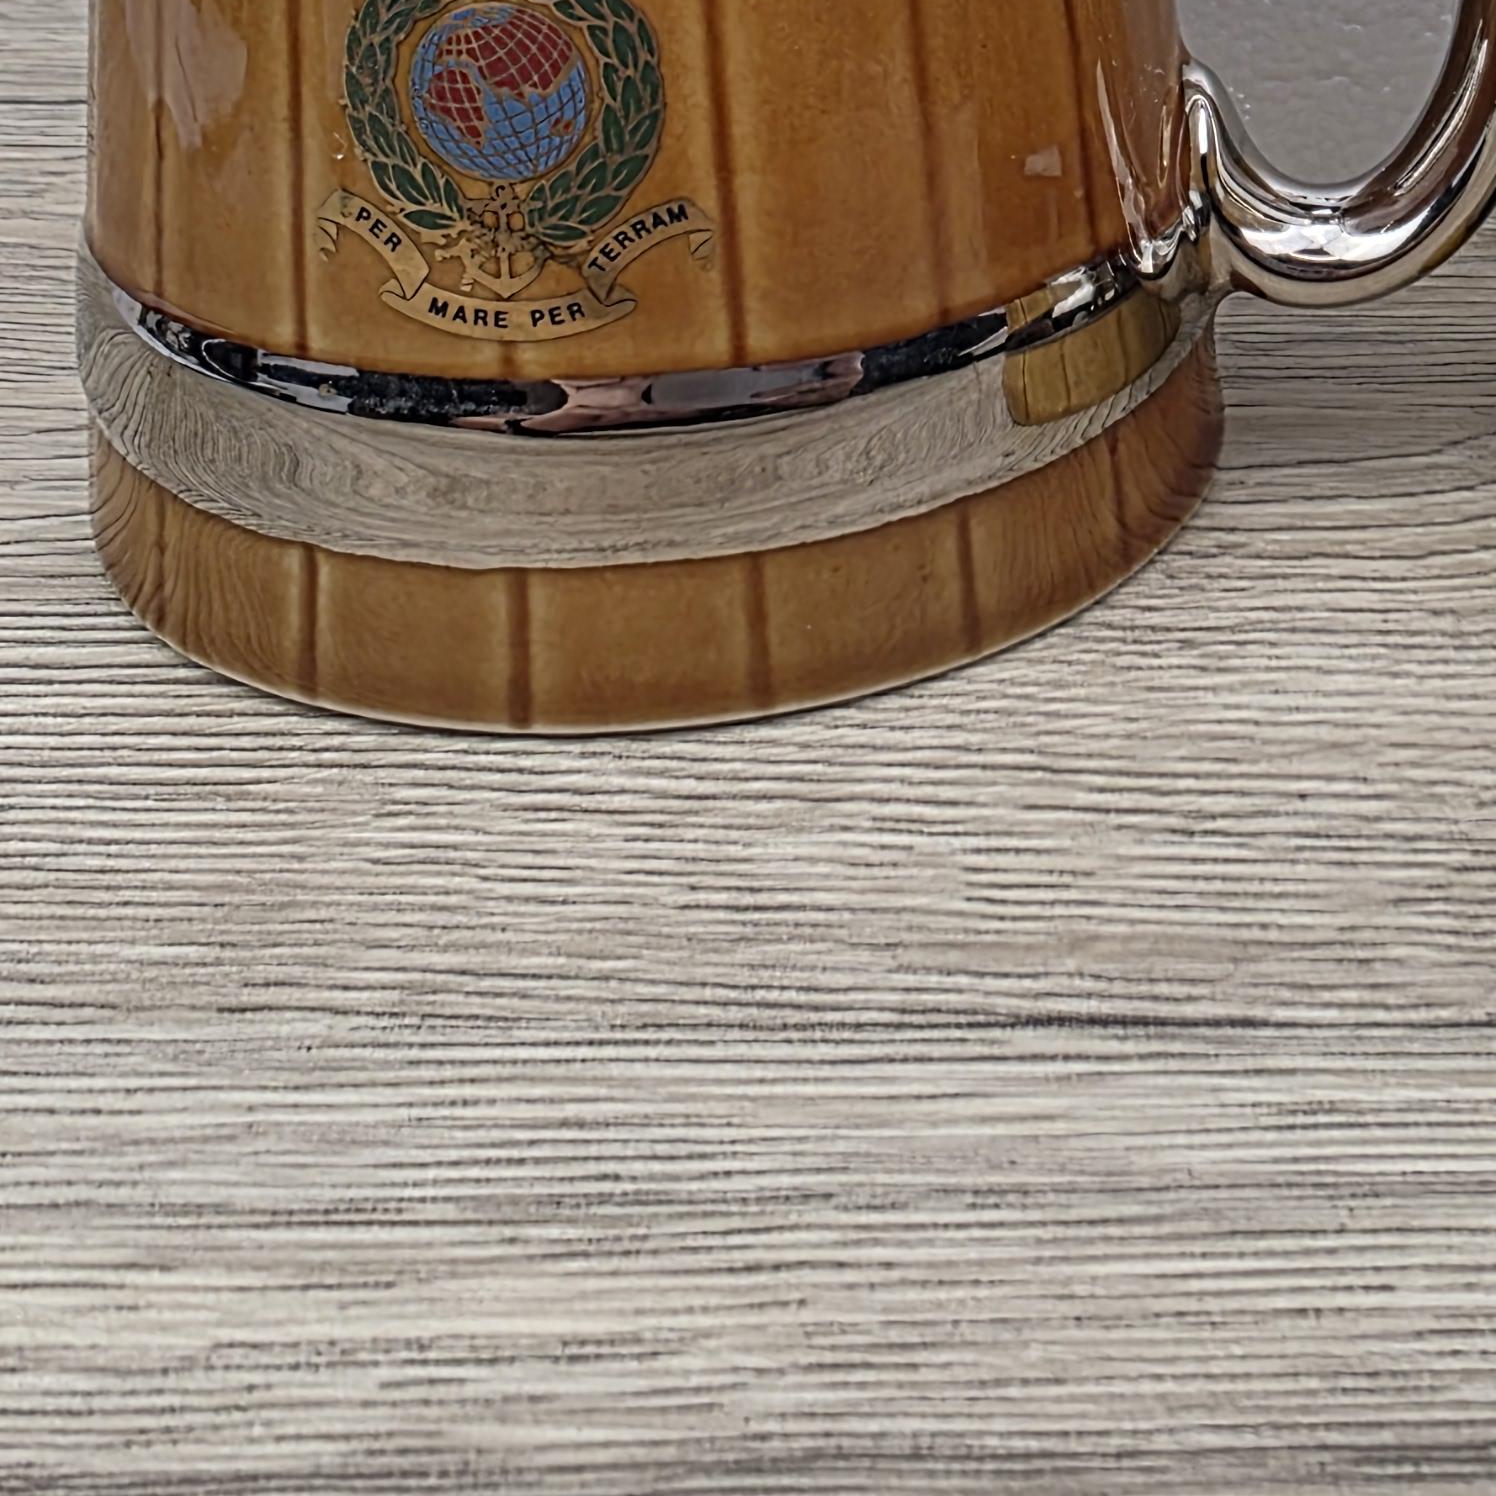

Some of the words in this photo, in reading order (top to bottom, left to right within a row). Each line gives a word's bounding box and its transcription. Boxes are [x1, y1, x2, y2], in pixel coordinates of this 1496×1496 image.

[355, 206, 401, 254] PER
[427, 297, 511, 330] MARE
[530, 302, 586, 329] PER
[586, 202, 690, 275] TERRAM
